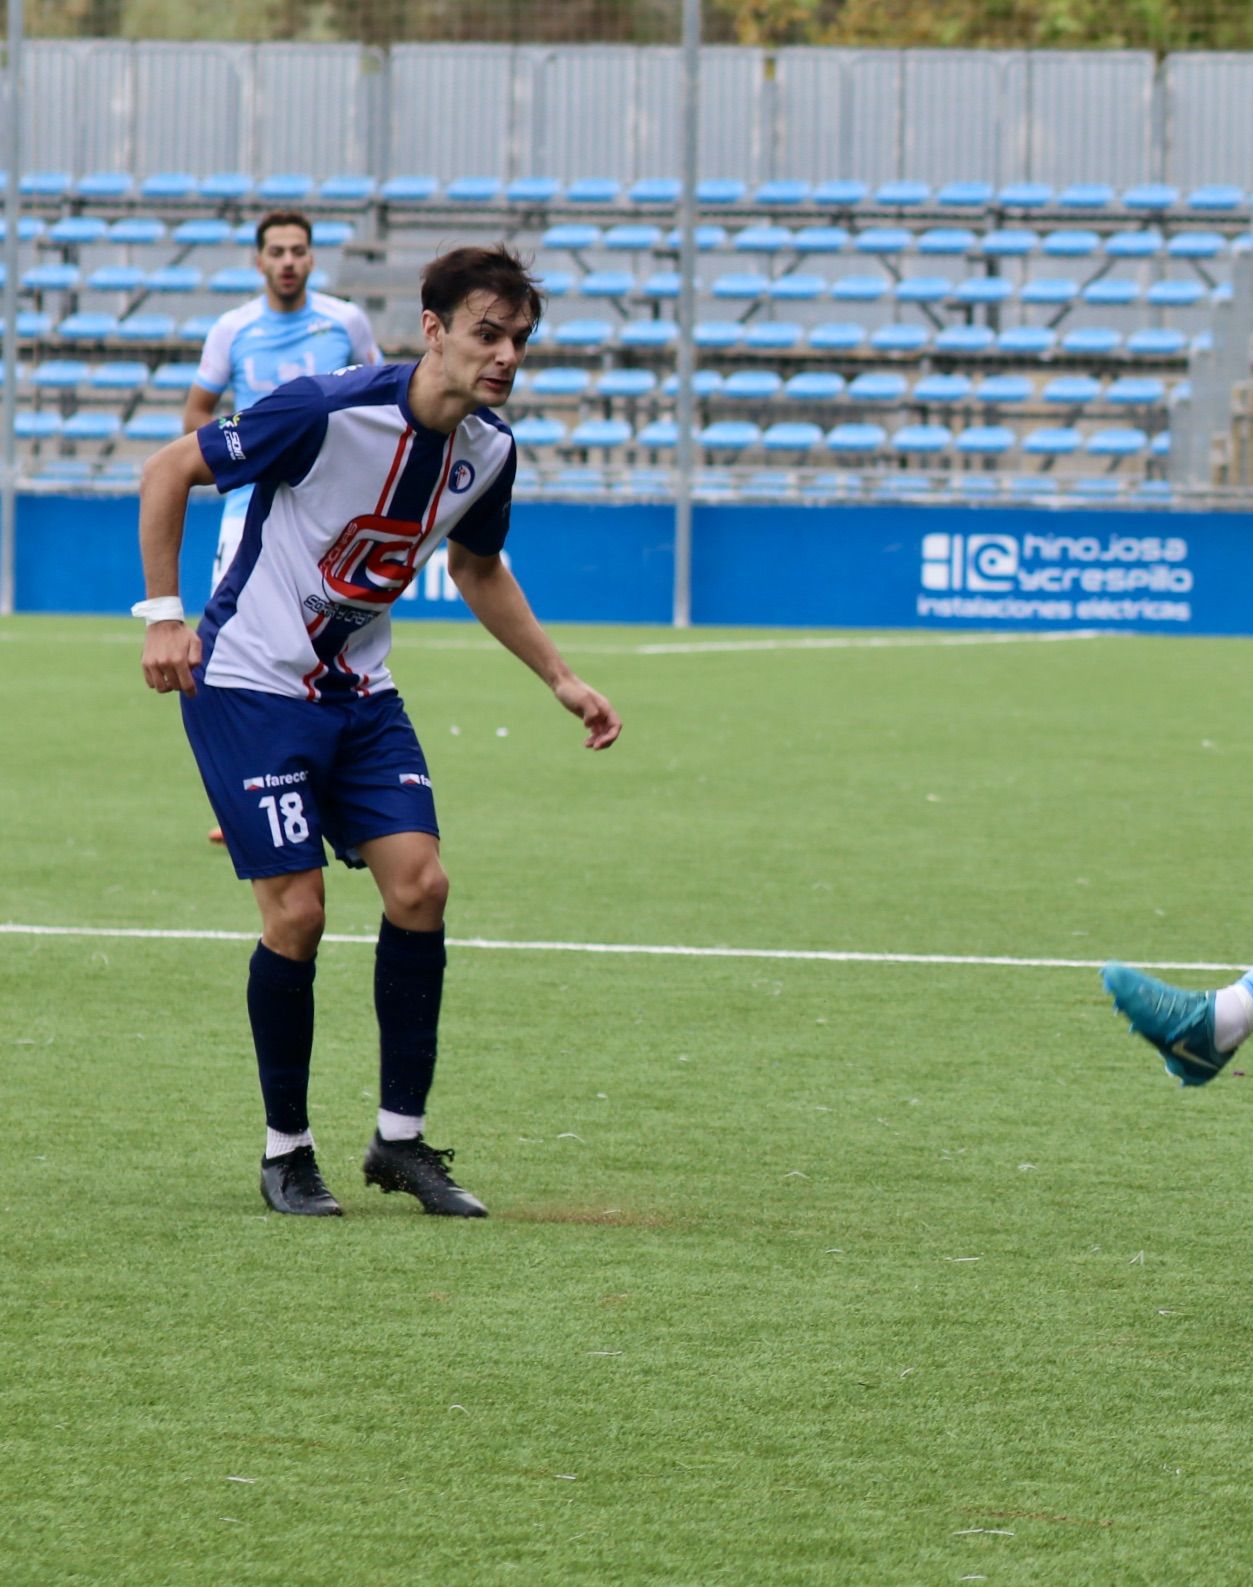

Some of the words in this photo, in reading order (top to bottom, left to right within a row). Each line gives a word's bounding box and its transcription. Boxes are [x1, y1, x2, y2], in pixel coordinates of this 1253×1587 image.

[1023, 532, 1188, 562] hinojosa
[917, 593, 1073, 619] instalaciones
[258, 791, 310, 848] 18
